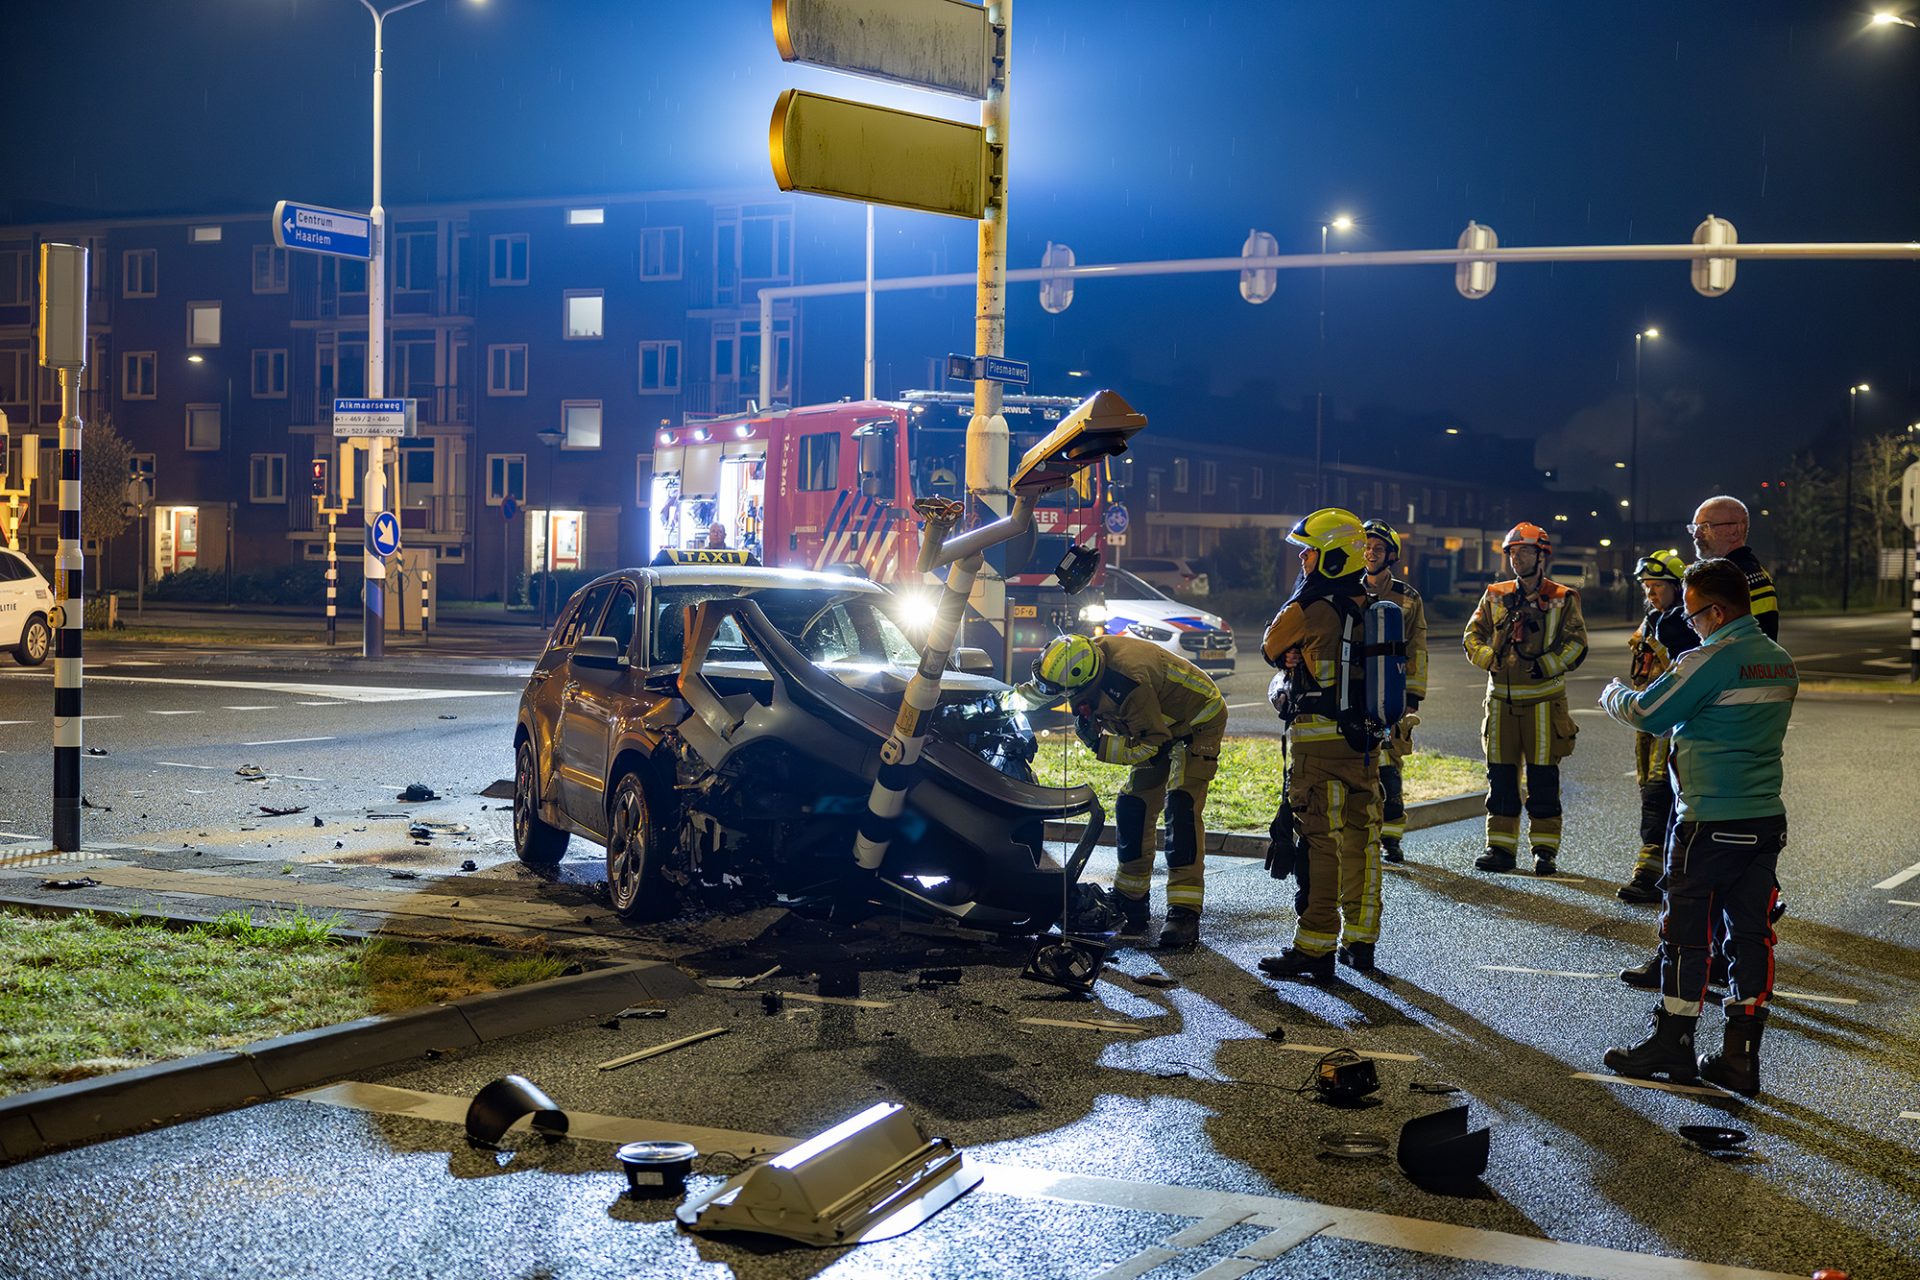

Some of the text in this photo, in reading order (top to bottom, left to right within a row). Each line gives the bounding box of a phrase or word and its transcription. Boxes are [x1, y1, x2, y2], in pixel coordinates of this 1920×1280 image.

[298, 212, 333, 227] Centrum
[296, 229, 331, 245] Haarlem
[989, 362, 1027, 380] Plesmanweg
[339, 401, 400, 411] Alkmaarseweg
[683, 552, 734, 562] TAXI
[1739, 663, 1796, 679] AMBULANC
